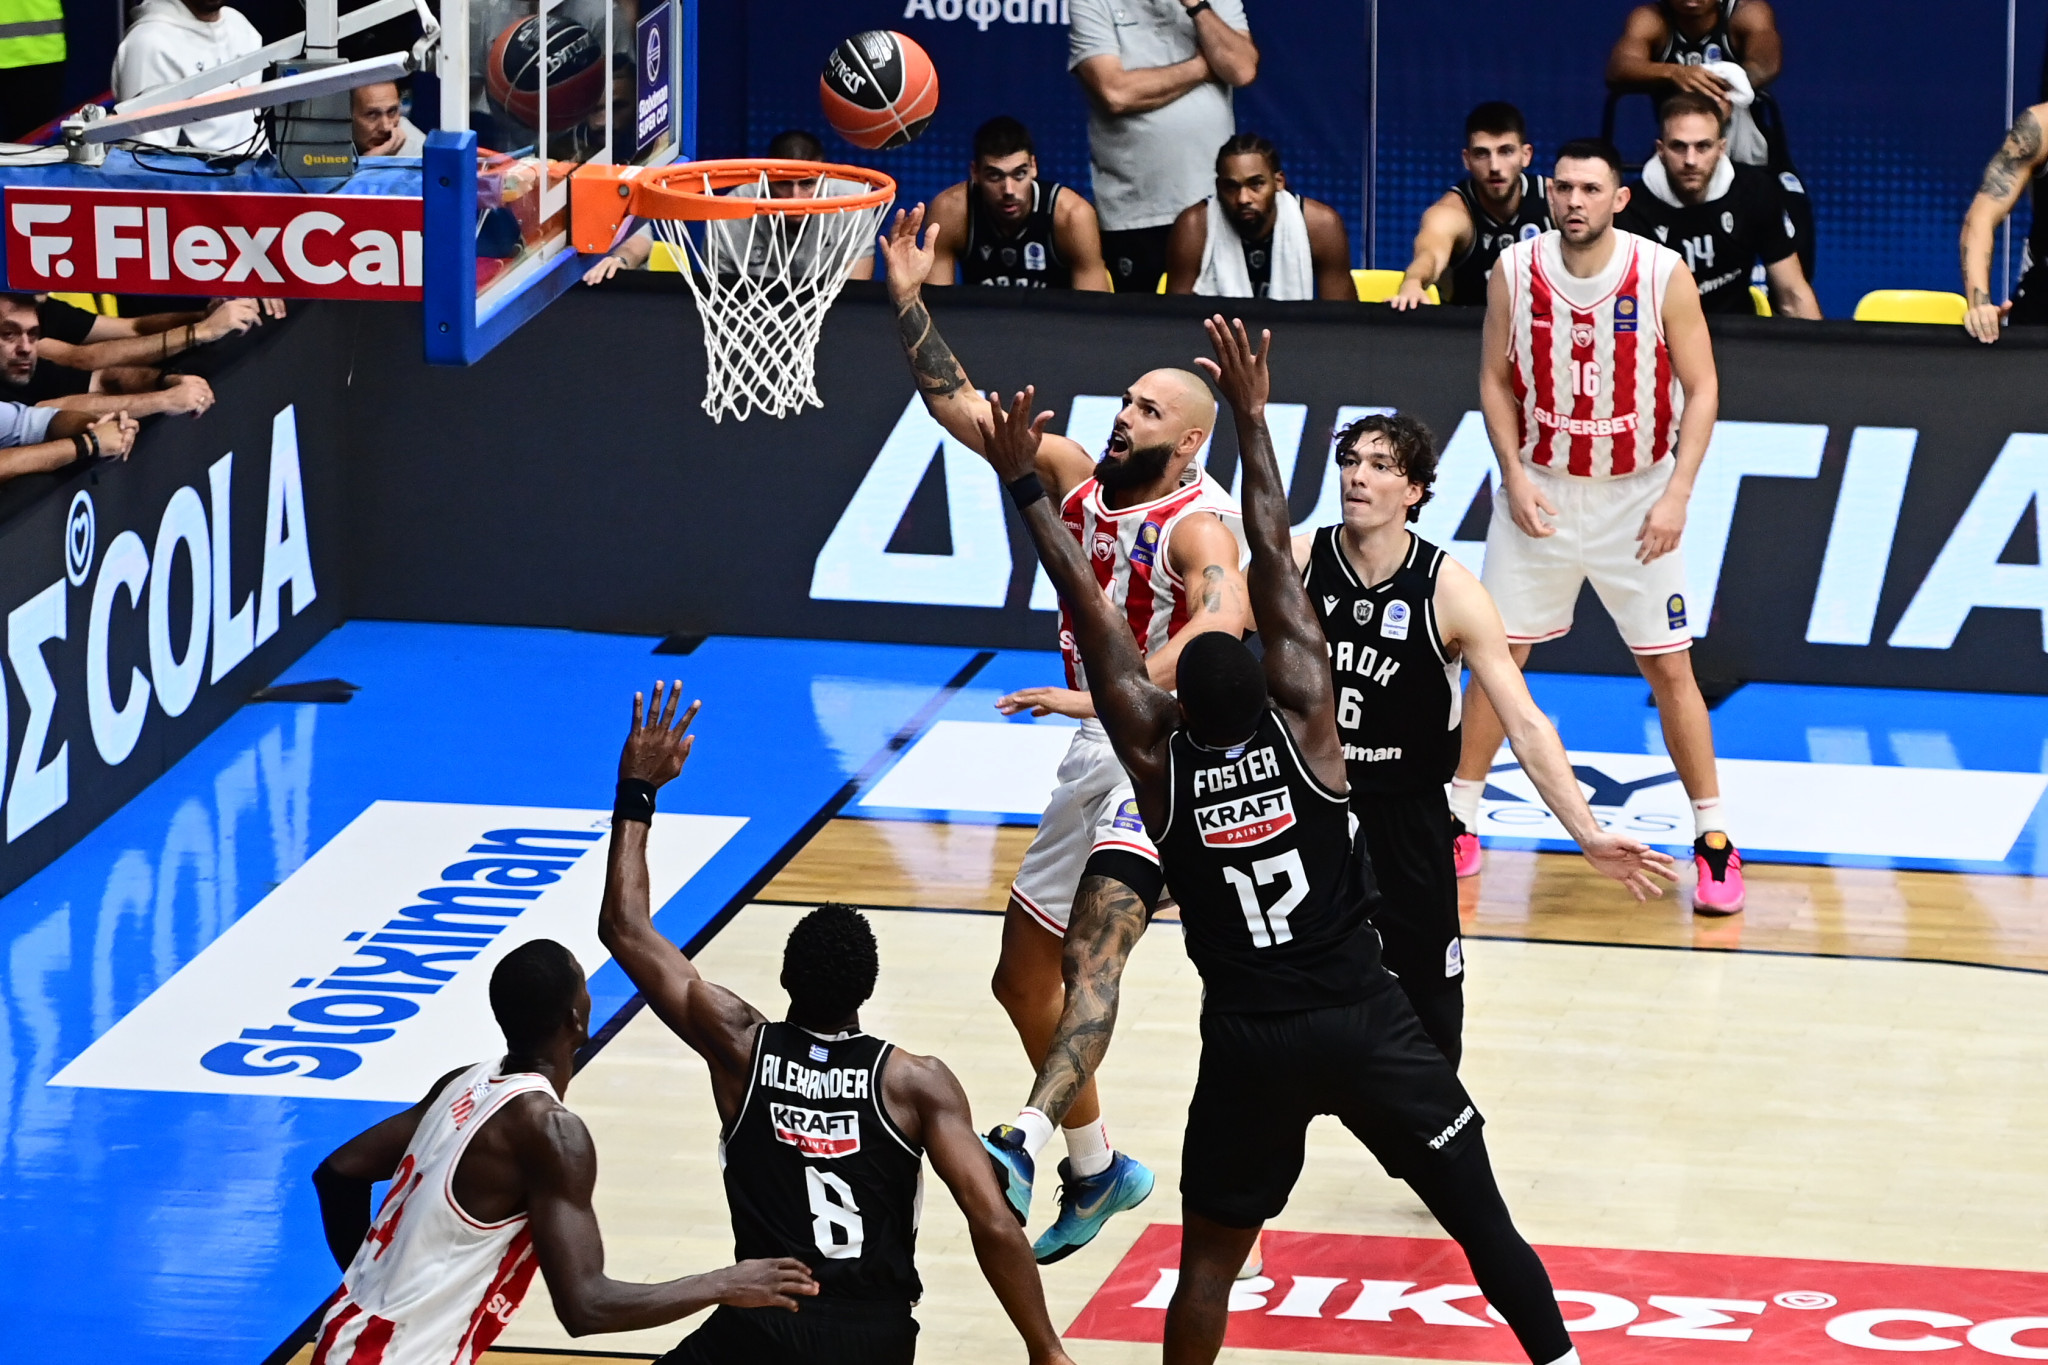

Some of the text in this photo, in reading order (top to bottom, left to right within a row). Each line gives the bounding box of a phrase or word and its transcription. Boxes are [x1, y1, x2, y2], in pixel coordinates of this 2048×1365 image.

[639, 104, 668, 139] SUPER CUP
[303, 153, 349, 165] Quince
[1682, 234, 1715, 273] 14
[1569, 360, 1601, 397] 16
[1533, 407, 1639, 437] SUPERBET
[87, 403, 317, 766] COLA
[1337, 687, 1364, 730] 6
[1194, 746, 1280, 798] FOSTER
[1341, 743, 1402, 762] iman
[1198, 791, 1287, 831] KRAFT
[1227, 823, 1273, 841] PAINTS
[200, 828, 606, 1080] Stoiximan
[761, 1054, 868, 1099] ALEXANDER
[773, 1106, 855, 1135] KRAFT
[794, 1138, 835, 1151] PAINTS
[805, 1166, 864, 1259] 8
[1825, 1309, 2048, 1360] CO
